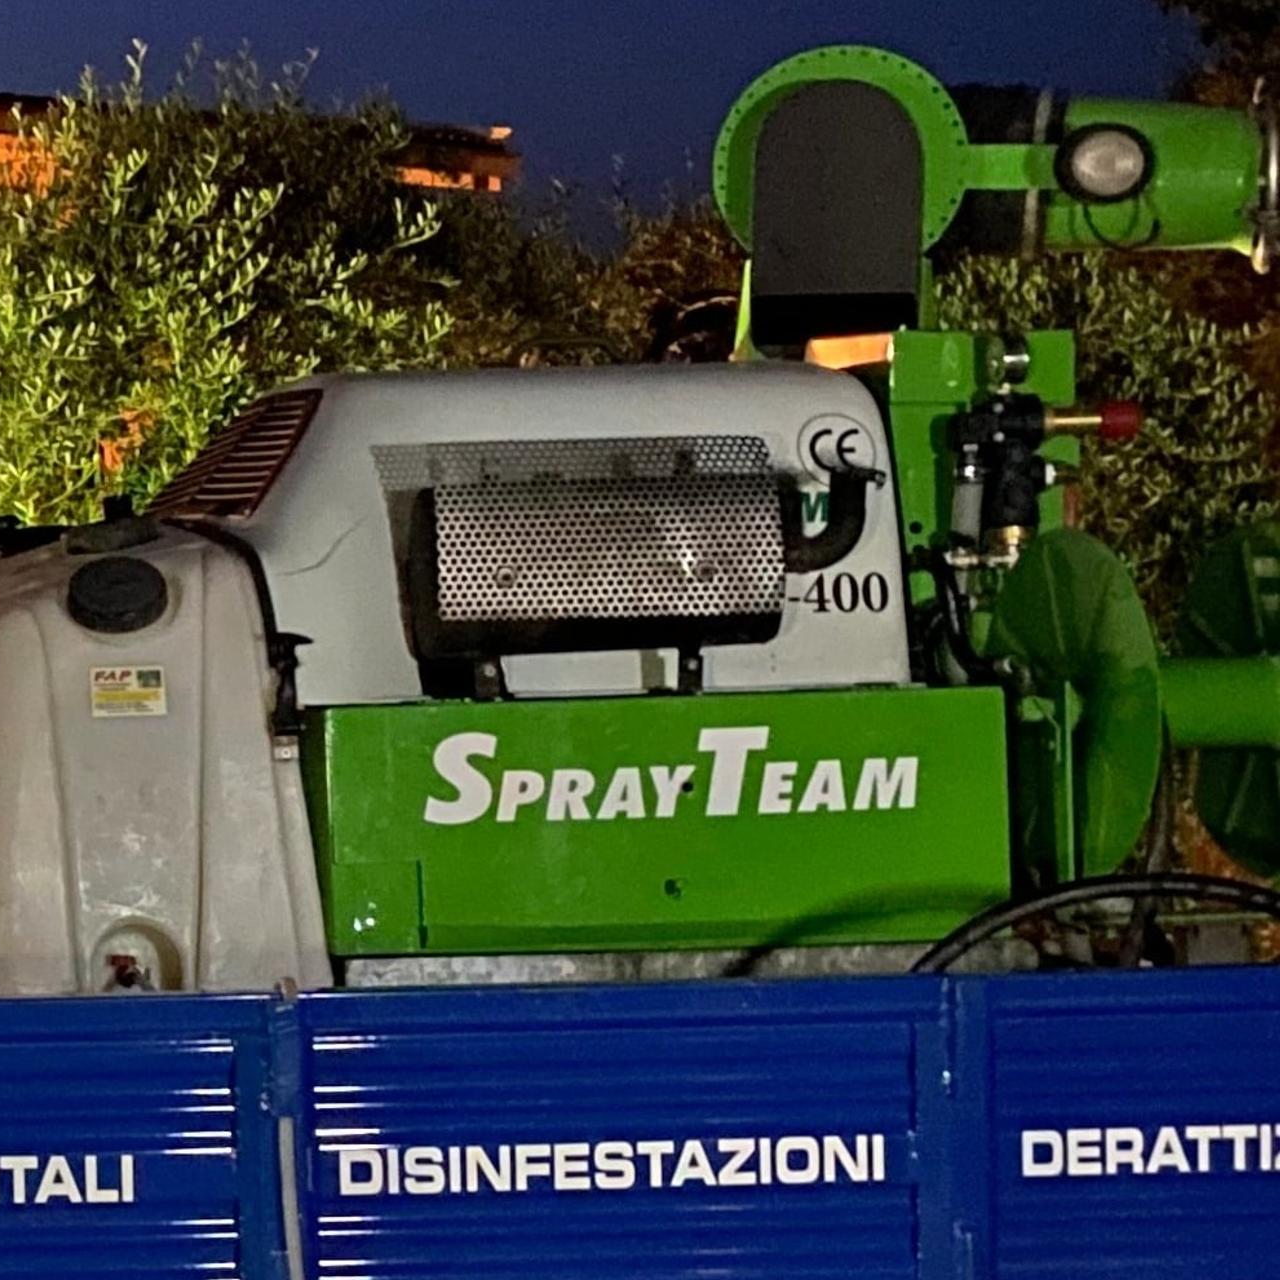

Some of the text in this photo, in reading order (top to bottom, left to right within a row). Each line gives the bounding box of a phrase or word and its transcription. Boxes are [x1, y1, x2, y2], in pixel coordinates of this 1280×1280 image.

[809, 428, 859, 470] CE
[339, 1134, 884, 1195] DISINFESTAZIONI
[1022, 1124, 1280, 1176] DERATTI
